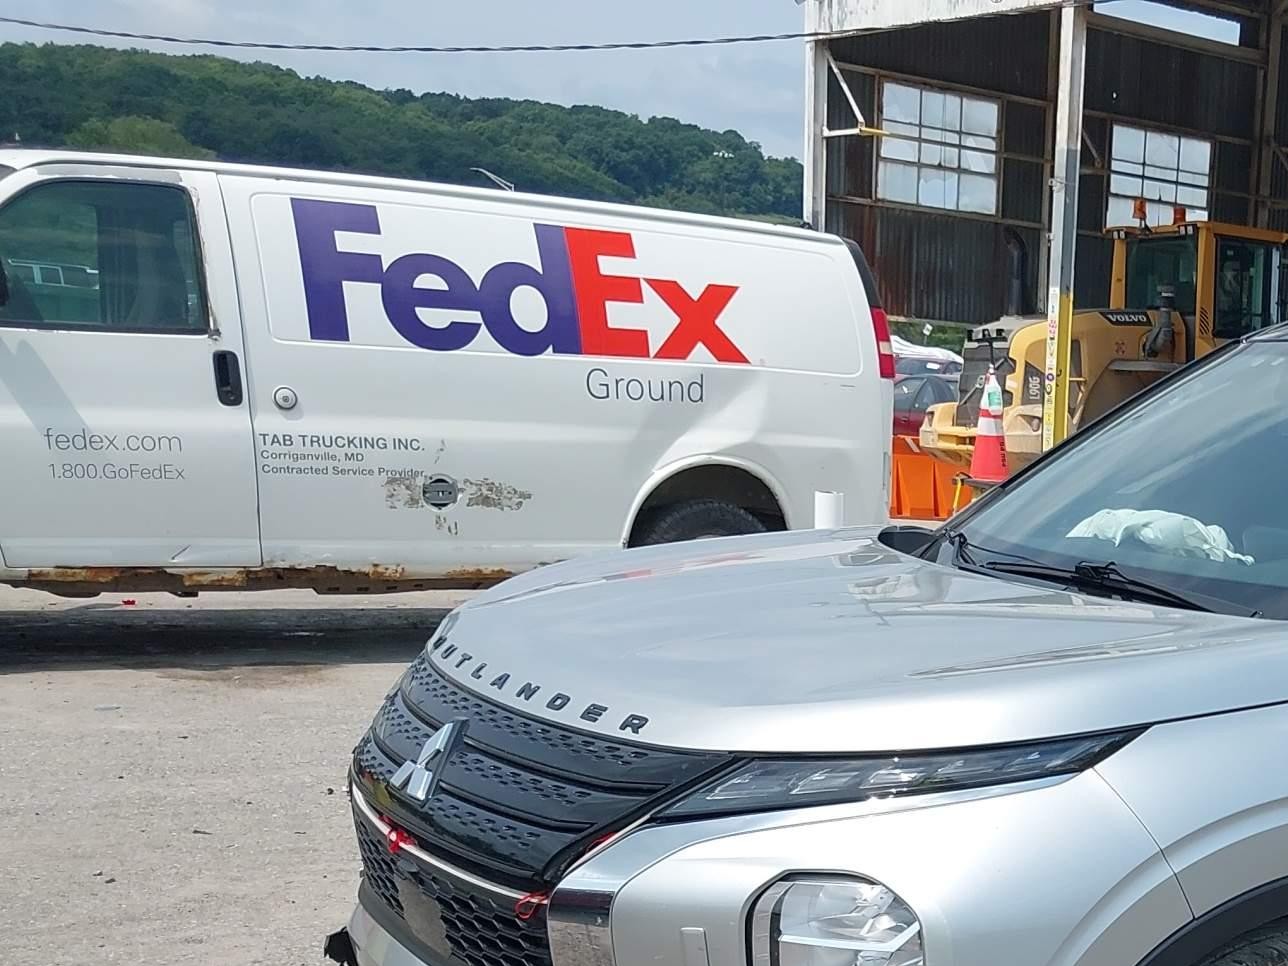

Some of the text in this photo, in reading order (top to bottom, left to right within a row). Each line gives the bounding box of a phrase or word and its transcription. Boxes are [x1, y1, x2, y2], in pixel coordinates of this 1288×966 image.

[289, 196, 752, 365] FedEx
[1106, 313, 1148, 322] VOLVO
[585, 366, 706, 404] Ground
[1028, 375, 1041, 400] L90G
[43, 427, 183, 453] fedex.com
[259, 432, 425, 451] TAB TRUCKING INC.
[260, 449, 365, 463] Corriganville, MD
[47, 463, 186, 480] 1.800.GoFedEx
[261, 463, 425, 478] Contracted Service Provider
[433, 635, 650, 735] OUTLANDER
